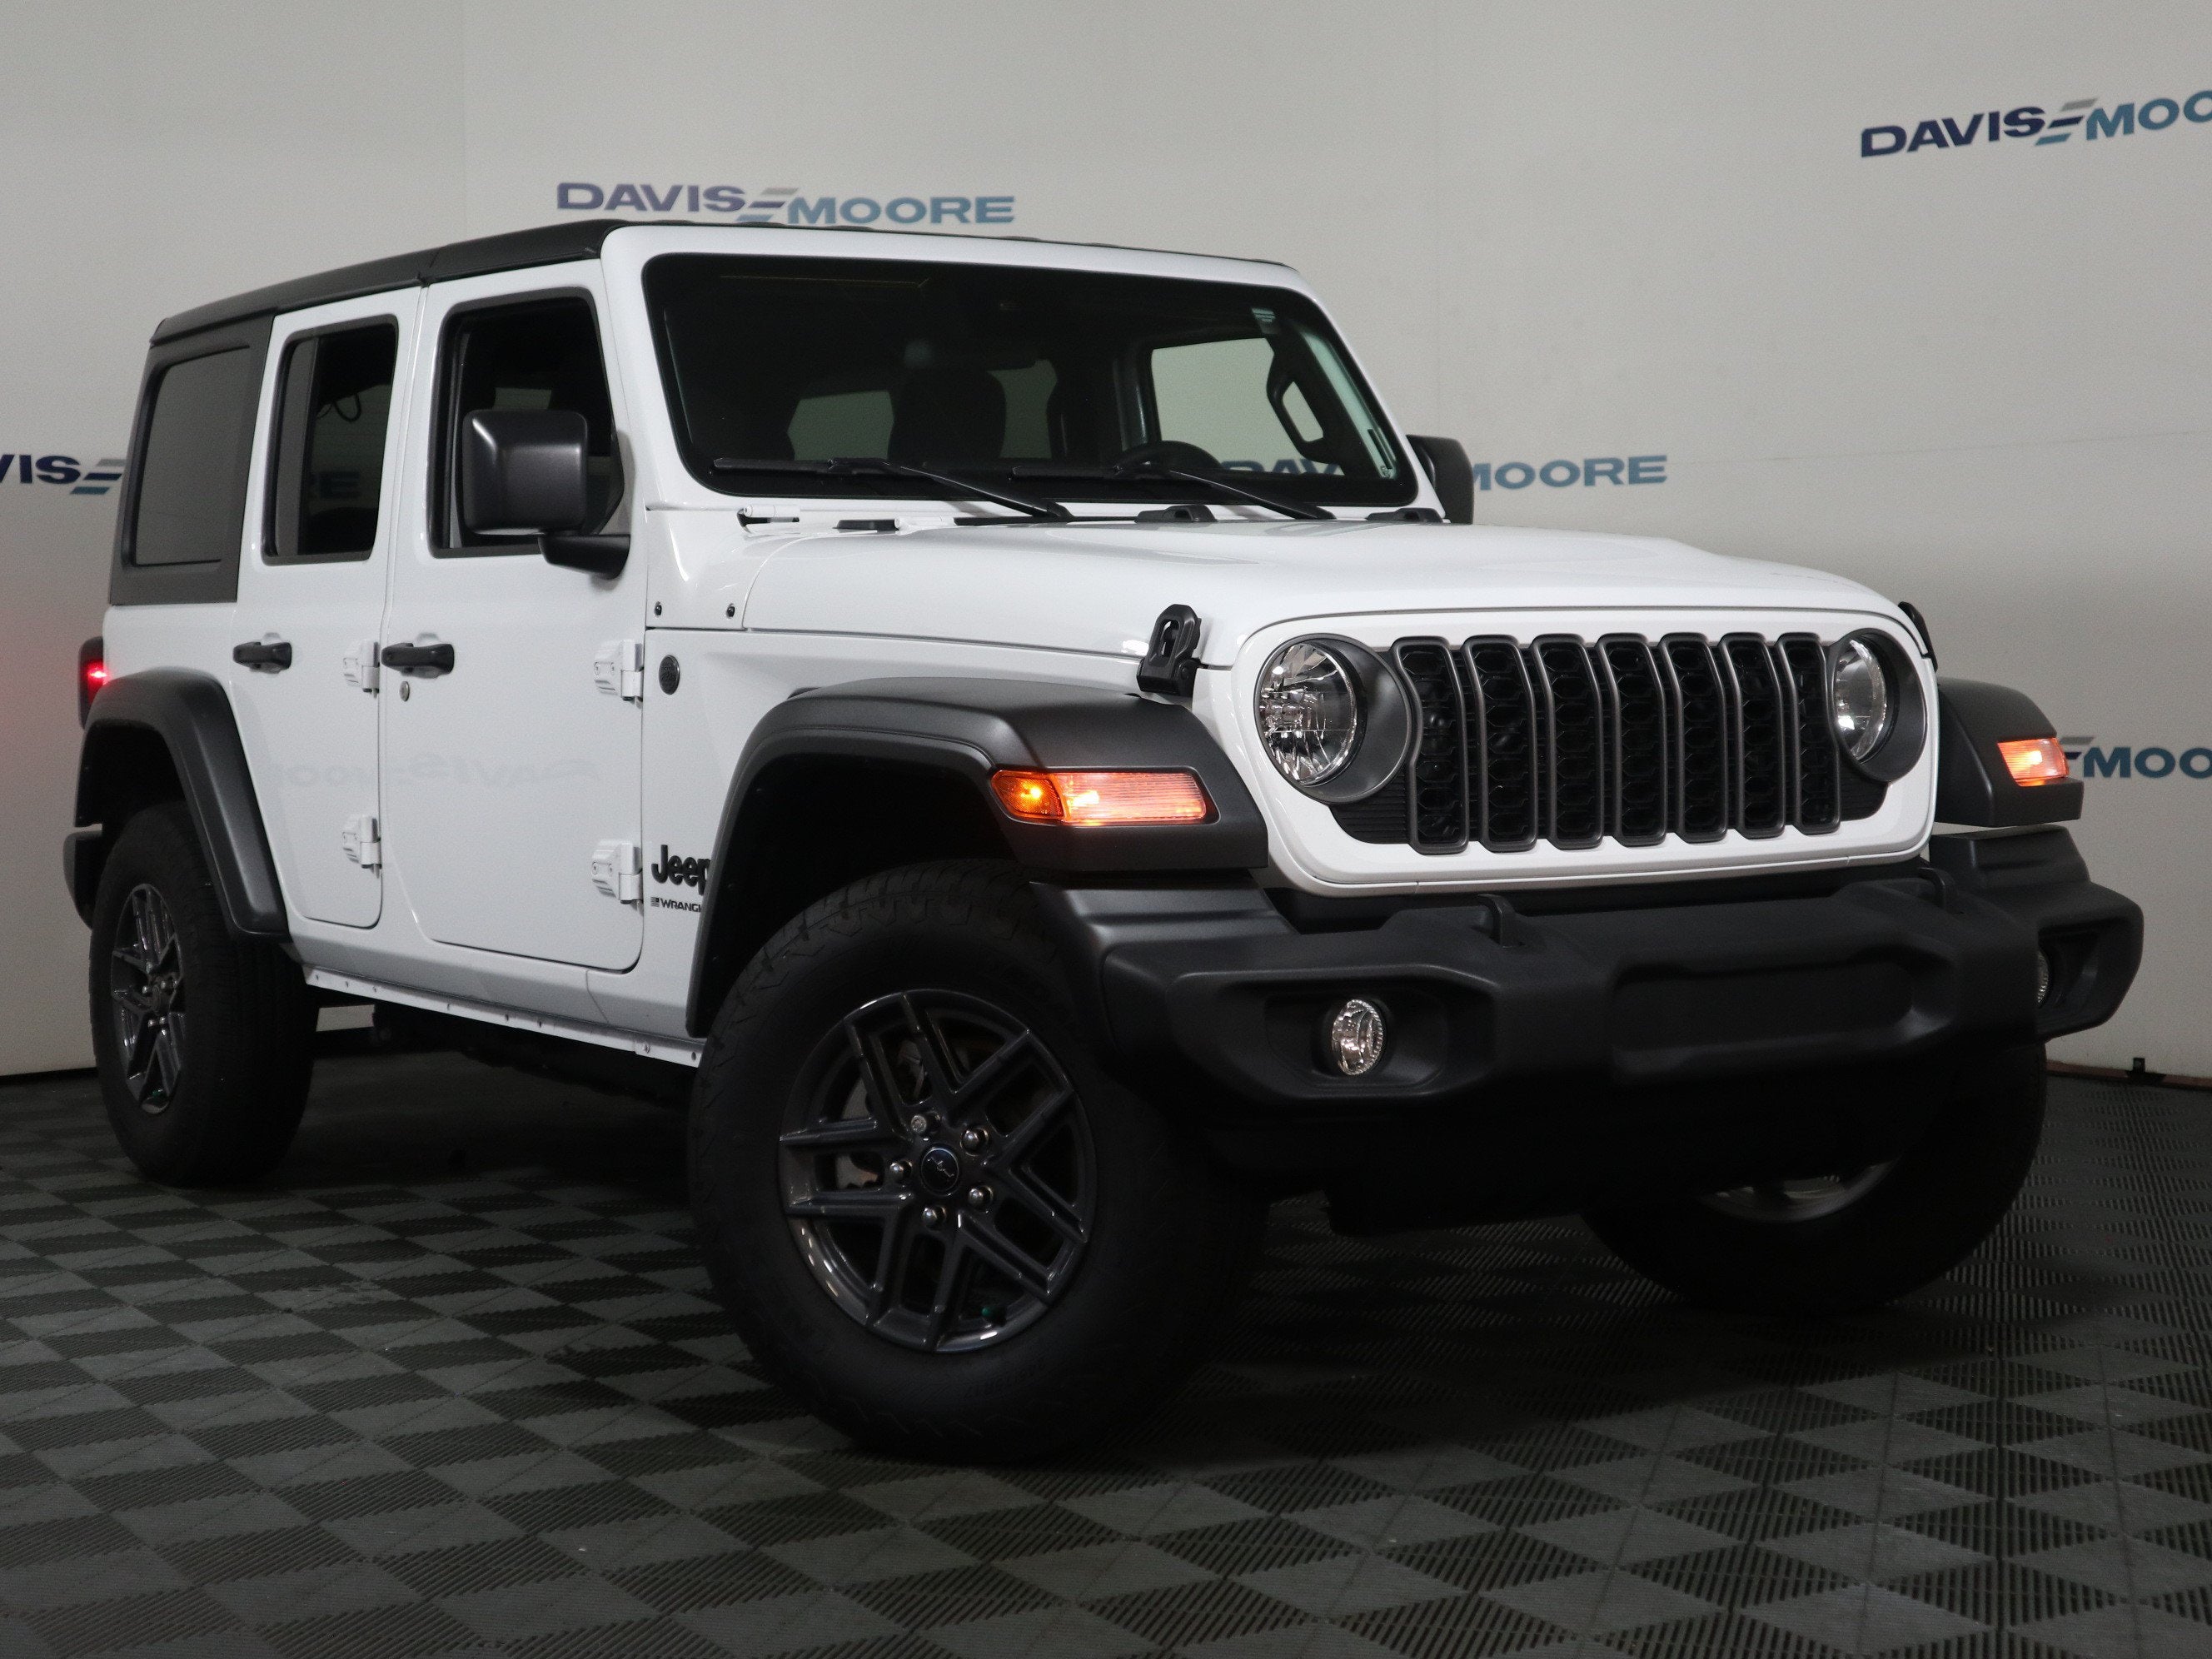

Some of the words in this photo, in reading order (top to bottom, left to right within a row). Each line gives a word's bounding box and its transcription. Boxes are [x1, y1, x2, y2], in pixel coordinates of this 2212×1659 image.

[1861, 106, 2046, 158] DAVIS
[2085, 89, 2212, 141] MOO
[556, 182, 749, 212] DAVIS
[786, 196, 1015, 225] MOORE
[2083, 746, 2212, 779] MOO
[651, 844, 711, 896] Jeep
